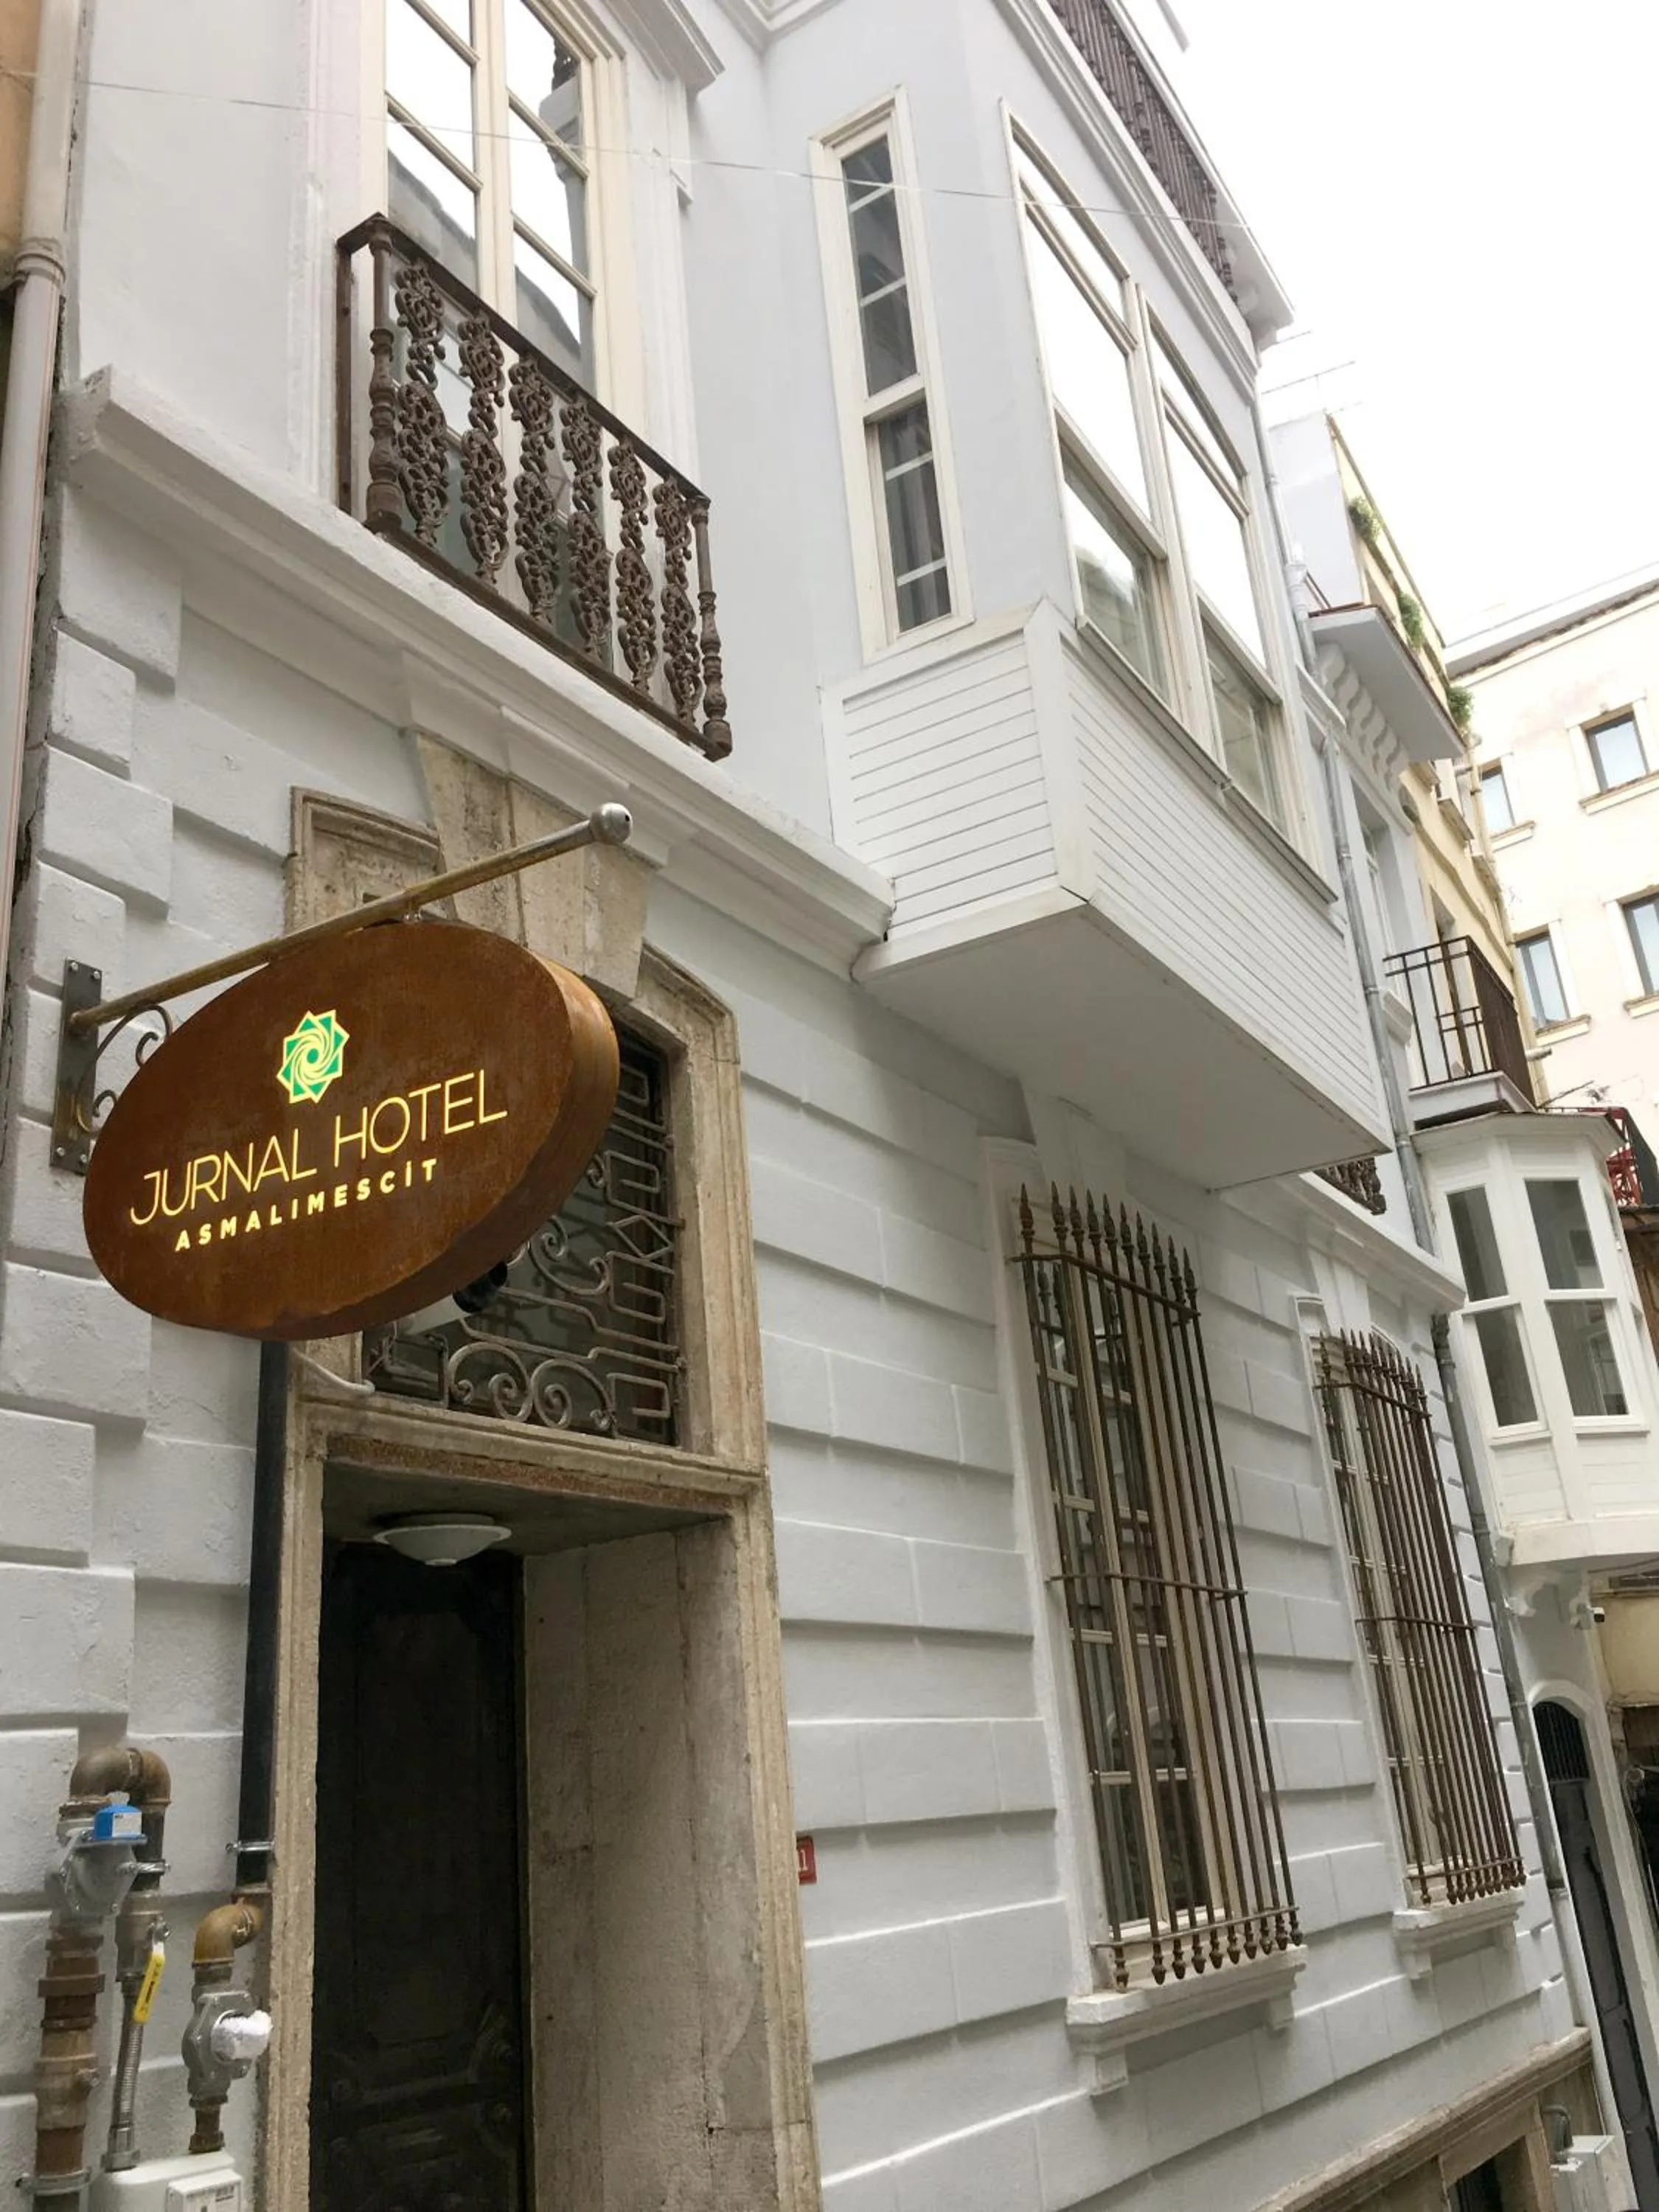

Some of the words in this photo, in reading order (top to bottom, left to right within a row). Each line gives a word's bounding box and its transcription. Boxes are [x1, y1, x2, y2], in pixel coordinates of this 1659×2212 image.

[131, 1127, 318, 1225] JURNAL
[333, 1068, 509, 1168] HOTEL
[174, 1158, 438, 1252] ASMALIMESCİT
